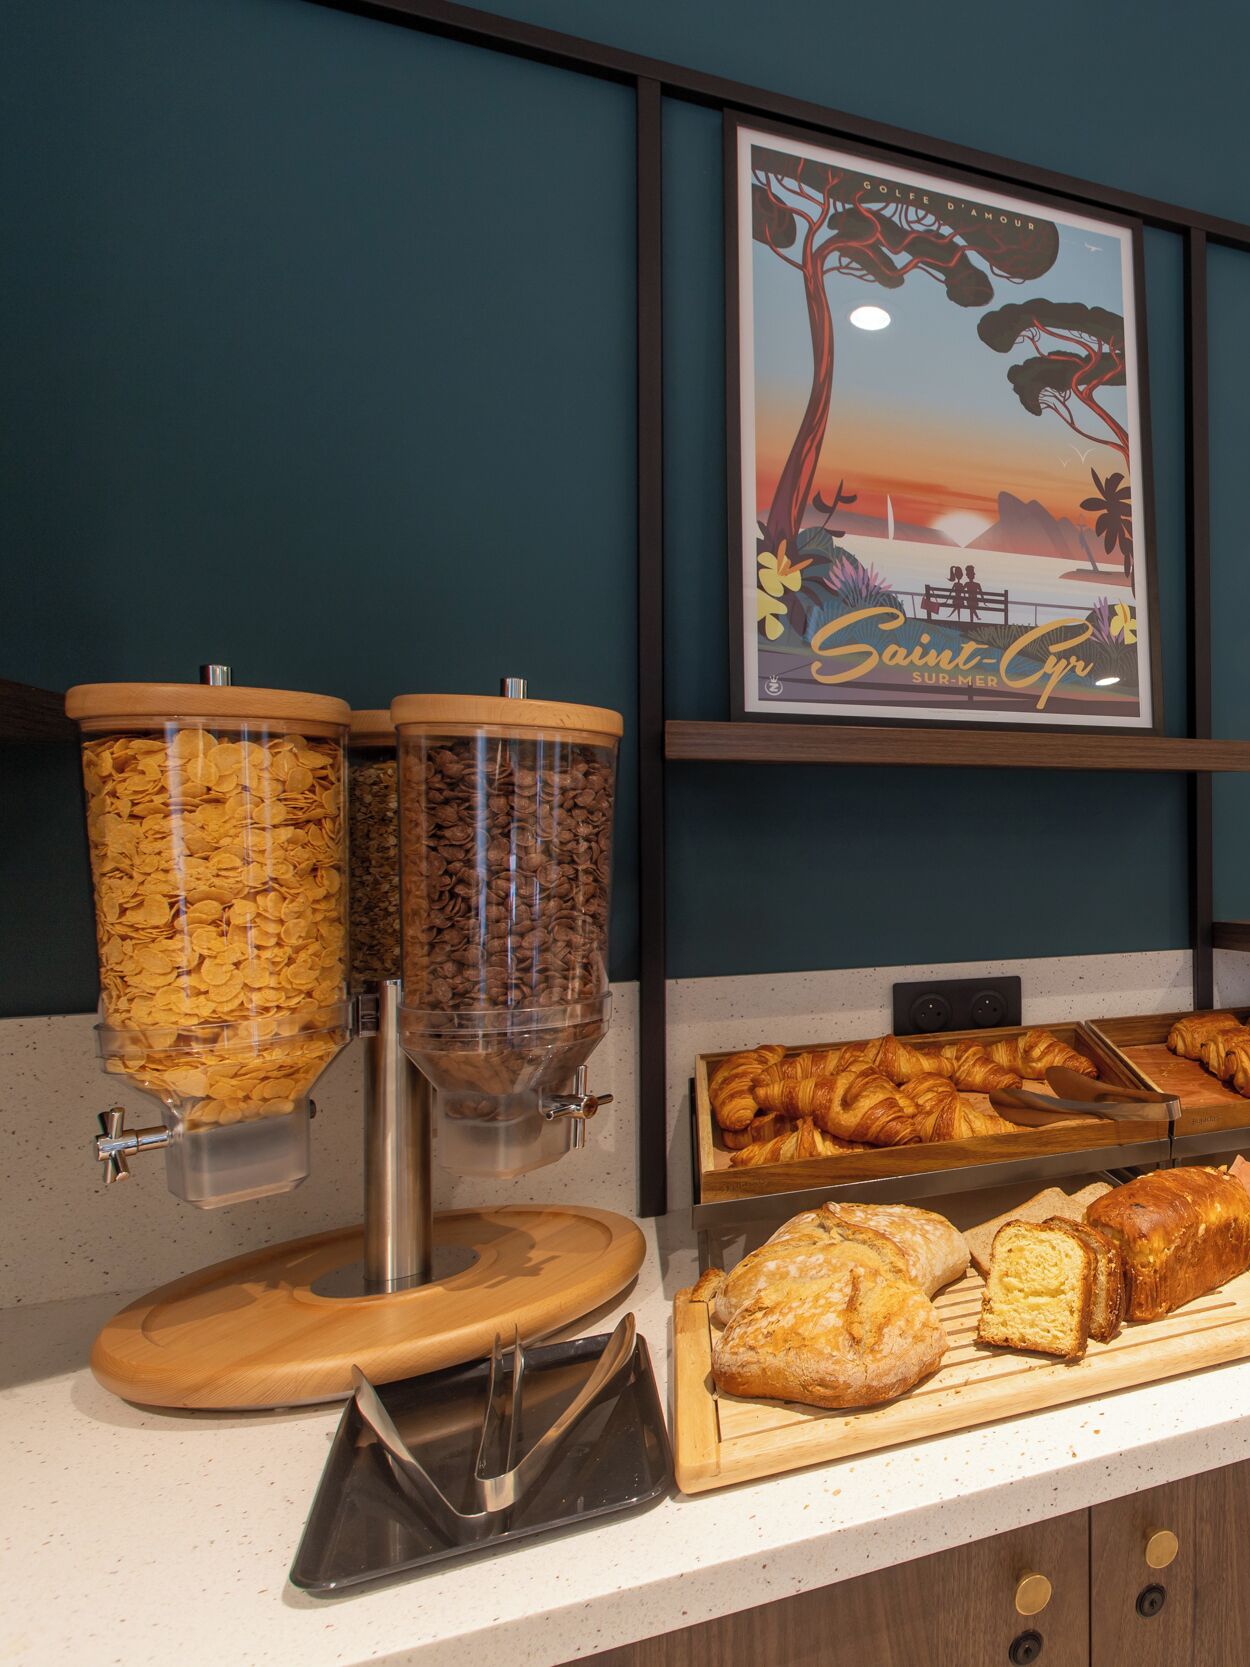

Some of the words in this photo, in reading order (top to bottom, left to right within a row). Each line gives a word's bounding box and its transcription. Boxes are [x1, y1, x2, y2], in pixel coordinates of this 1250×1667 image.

[863, 181, 929, 204] GOLFE
[947, 202, 1035, 231] D'AMOUR
[811, 606, 1094, 710] Saint-Cyr
[912, 671, 999, 688] SUR-MER
